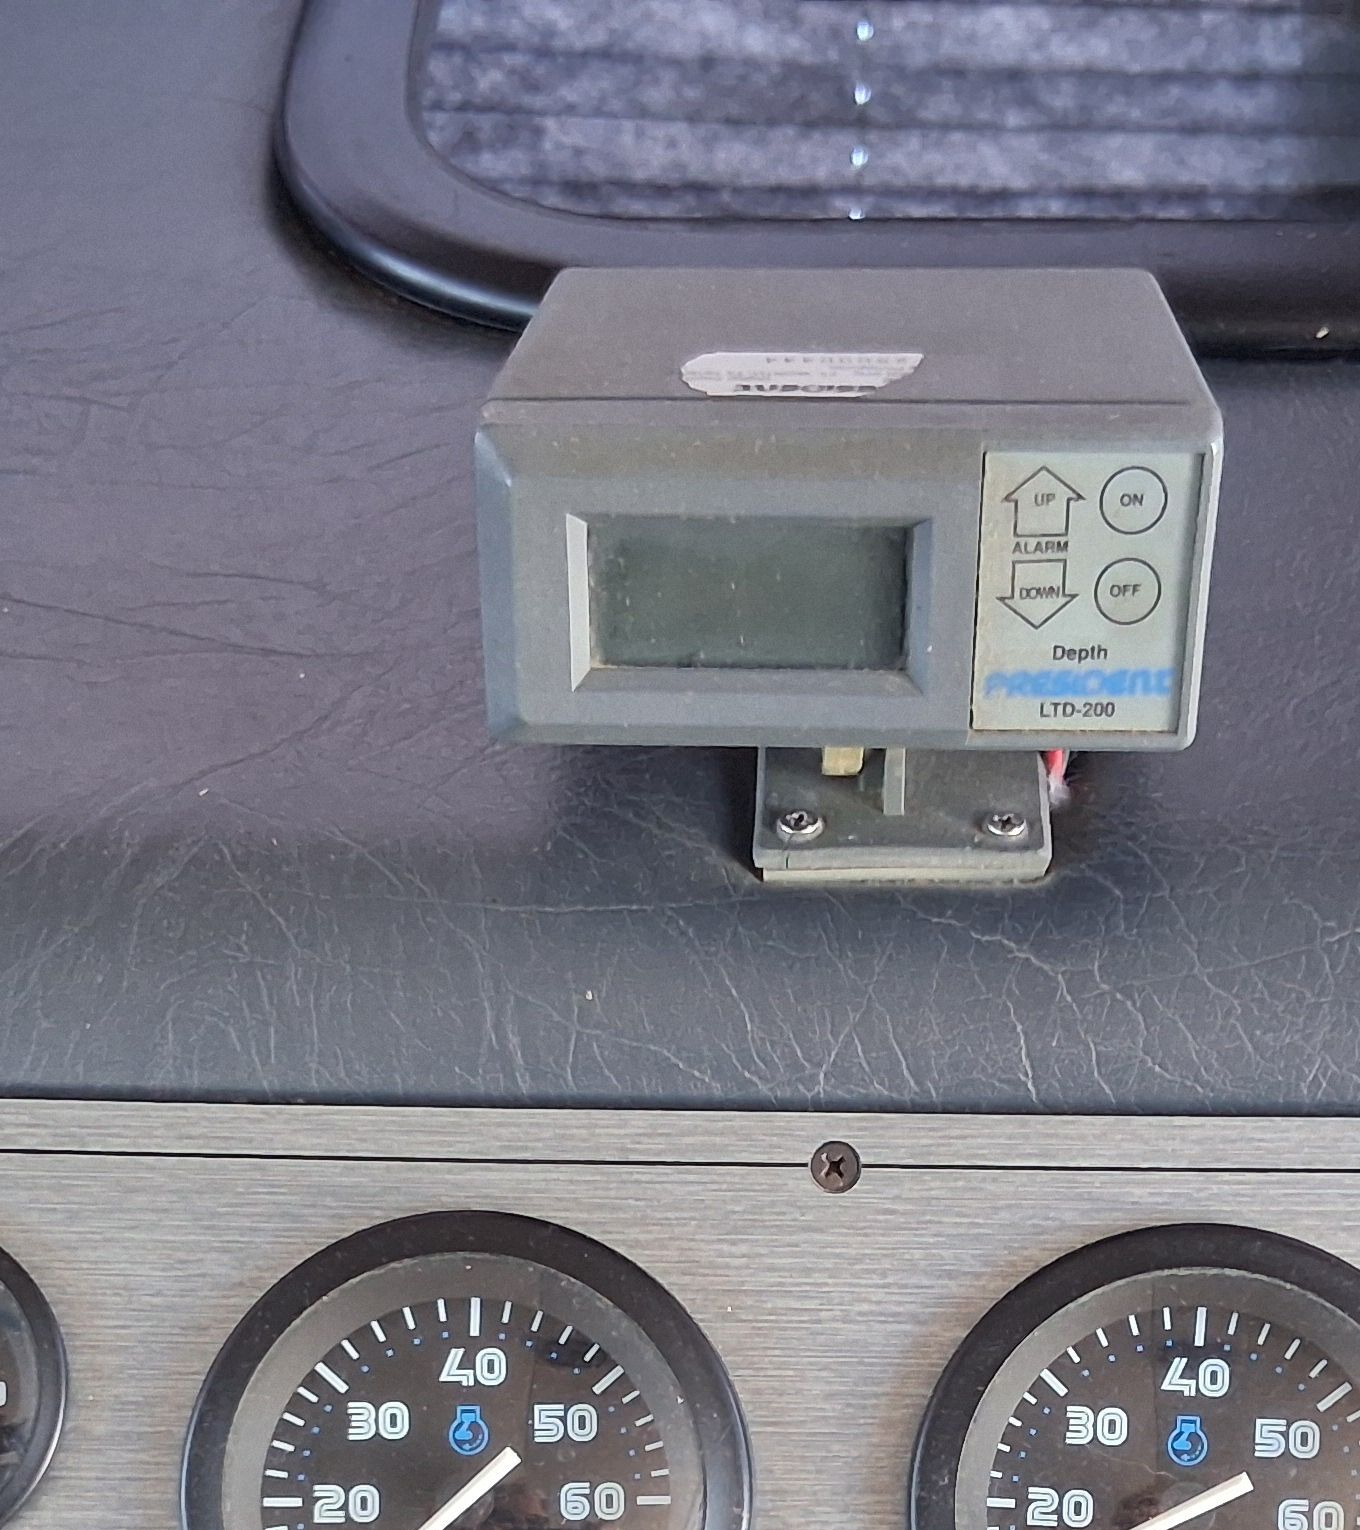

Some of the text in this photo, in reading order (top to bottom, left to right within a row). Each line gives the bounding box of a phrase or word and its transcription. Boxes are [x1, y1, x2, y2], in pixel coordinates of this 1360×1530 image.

[1034, 493, 1056, 506] UP
[1120, 493, 1144, 507] ON
[1012, 541, 1069, 554] ALARM
[1019, 587, 1061, 599] DOWN
[1110, 584, 1142, 597] OFF
[1052, 645, 1108, 664] Depth
[1039, 702, 1116, 718] LTD-200
[439, 1347, 508, 1386] 40
[1160, 1356, 1231, 1398] 40
[346, 1400, 410, 1441] 30
[533, 1403, 598, 1443] 50
[1065, 1405, 1129, 1446] 30
[1253, 1418, 1321, 1459] 50
[312, 1483, 380, 1525] 20
[559, 1481, 626, 1522] 60
[1026, 1486, 1094, 1529] 20
